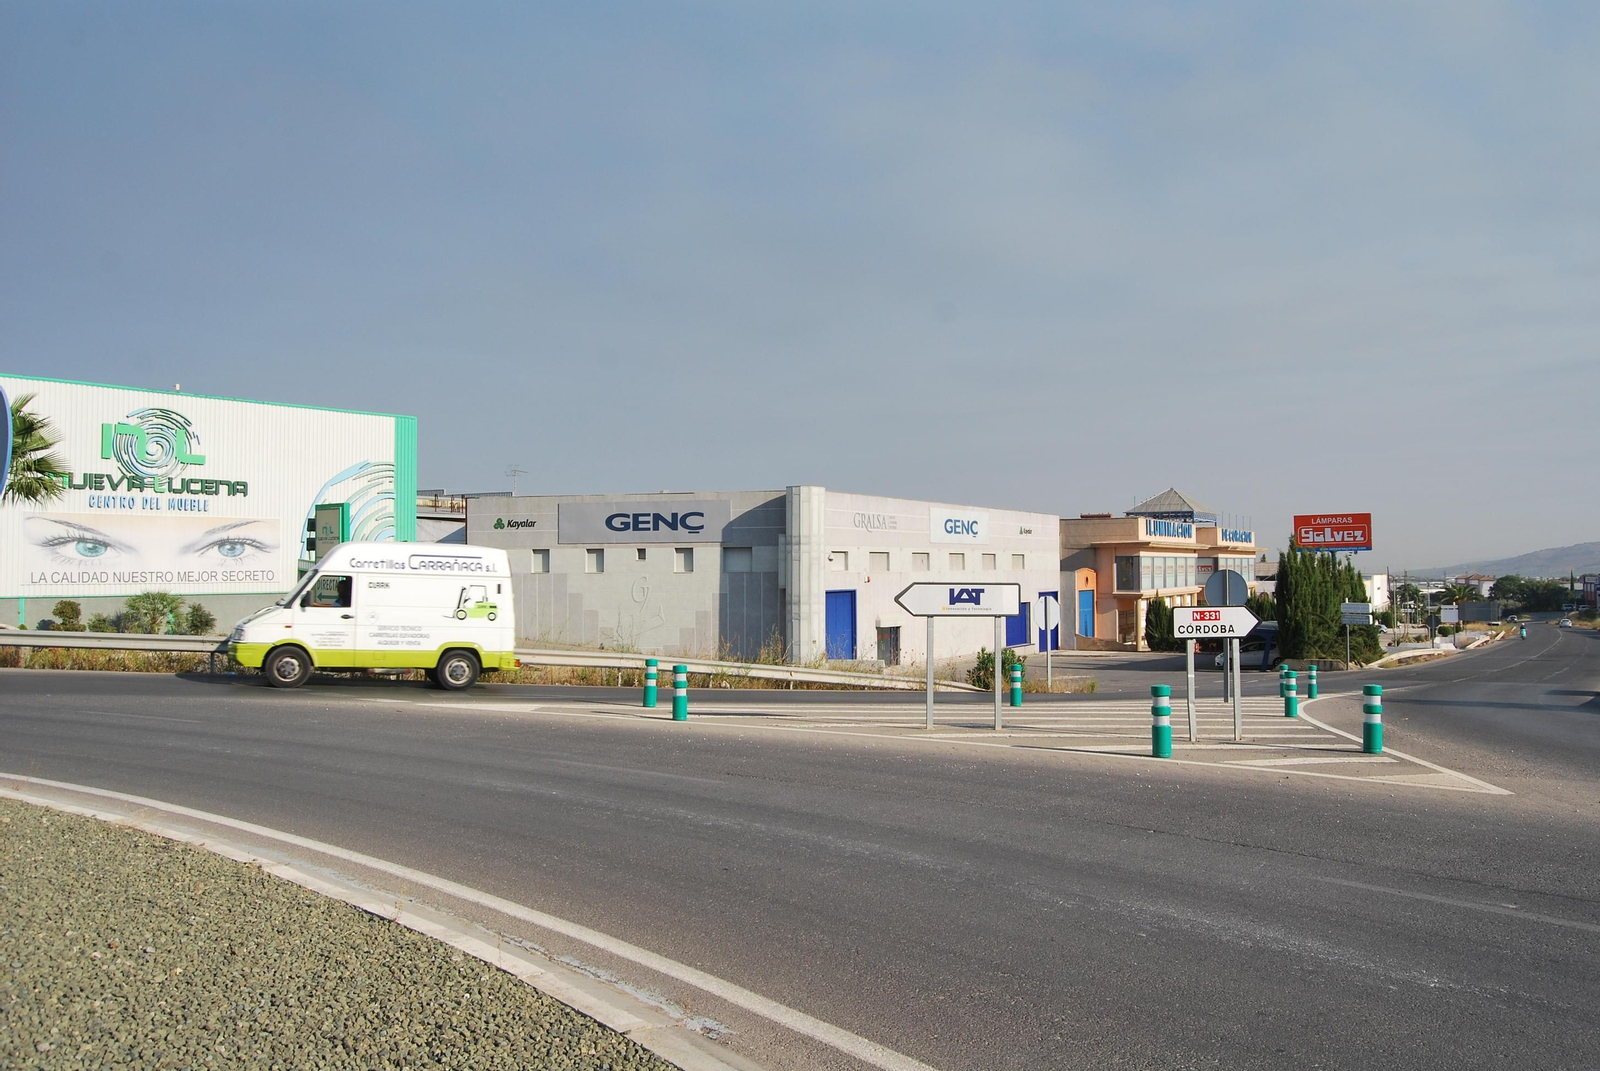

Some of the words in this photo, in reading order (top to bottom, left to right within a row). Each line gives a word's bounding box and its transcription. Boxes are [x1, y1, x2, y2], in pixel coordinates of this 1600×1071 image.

[88, 494, 135, 510] CENTRO
[142, 496, 161, 511] DEL
[168, 498, 210, 512] MUEBLE
[605, 511, 704, 534] GENÇ
[853, 512, 888, 533] GRALSA
[944, 518, 979, 538] GENÇ
[350, 557, 406, 570] Carretillas
[31, 571, 48, 584] LA
[50, 571, 109, 584] CALIDAD
[112, 571, 174, 583] NUESTRO
[177, 570, 218, 583] MEJOR
[221, 569, 275, 582] SECRETO
[949, 588, 985, 605] IAT
[1193, 611, 1220, 620] N-331
[1178, 623, 1235, 634] CÓRDOBA
